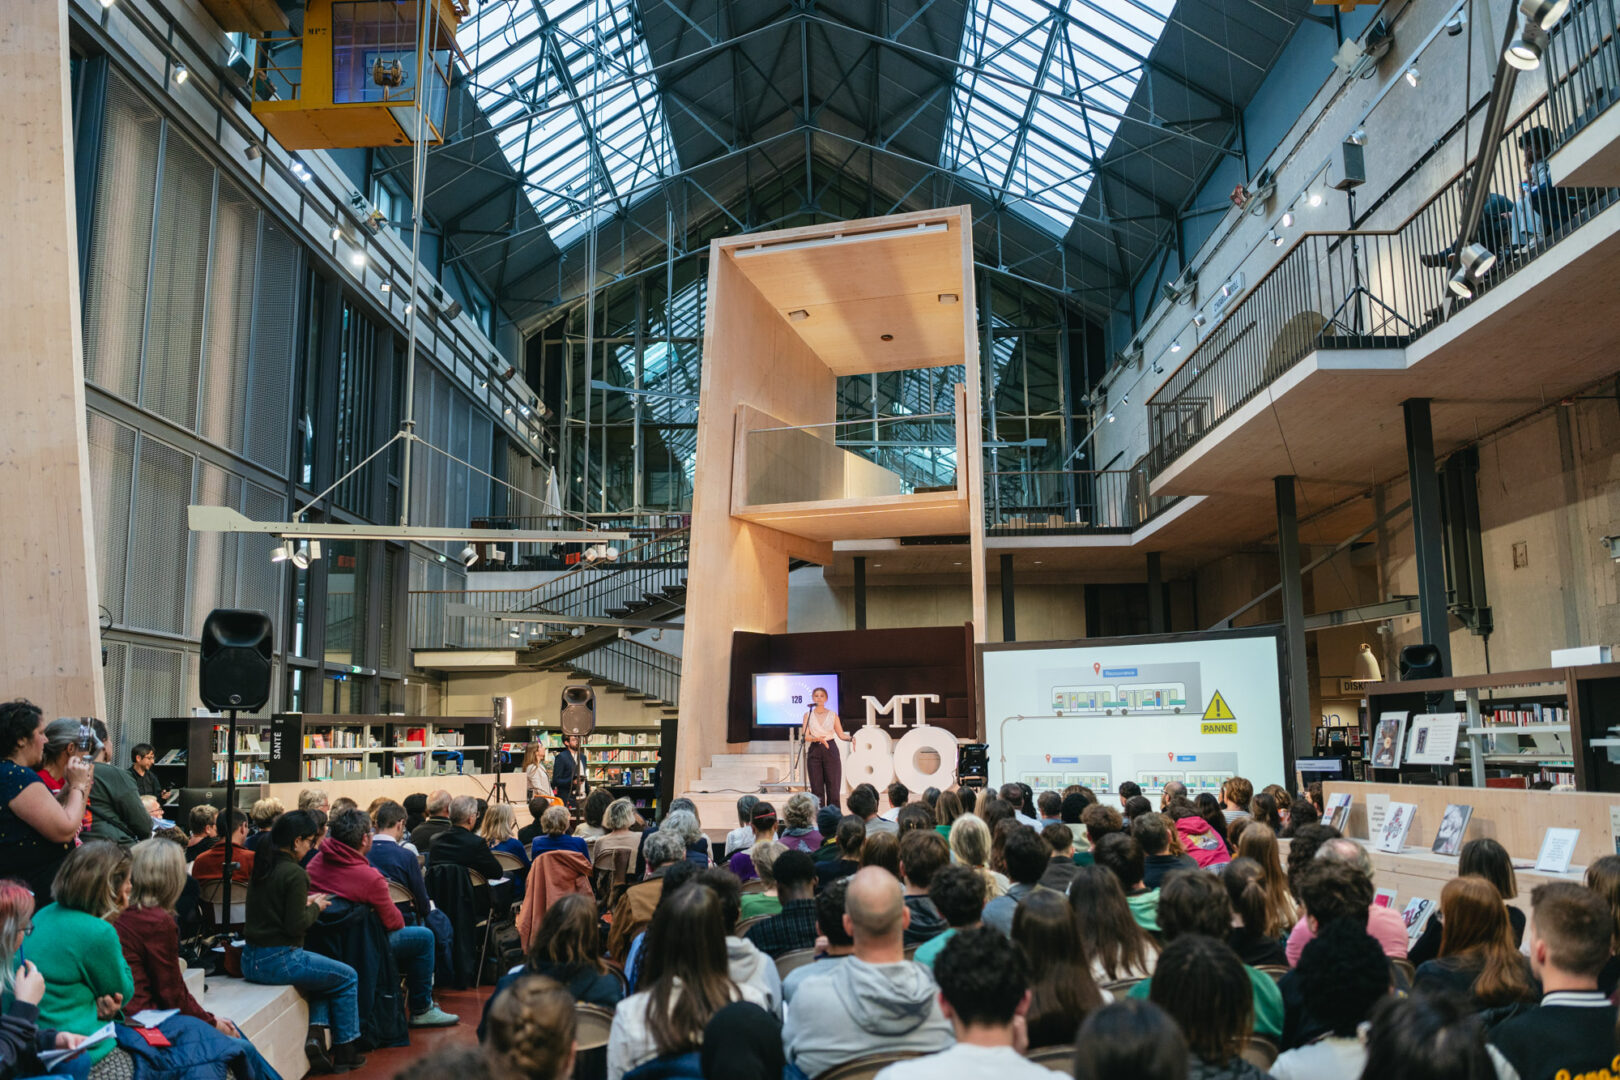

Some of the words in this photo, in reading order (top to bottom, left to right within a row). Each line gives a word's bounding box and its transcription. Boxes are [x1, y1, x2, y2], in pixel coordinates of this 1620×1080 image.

[791, 695, 803, 704] 128
[861, 693, 940, 728] MT
[1203, 724, 1233, 733] PANNE
